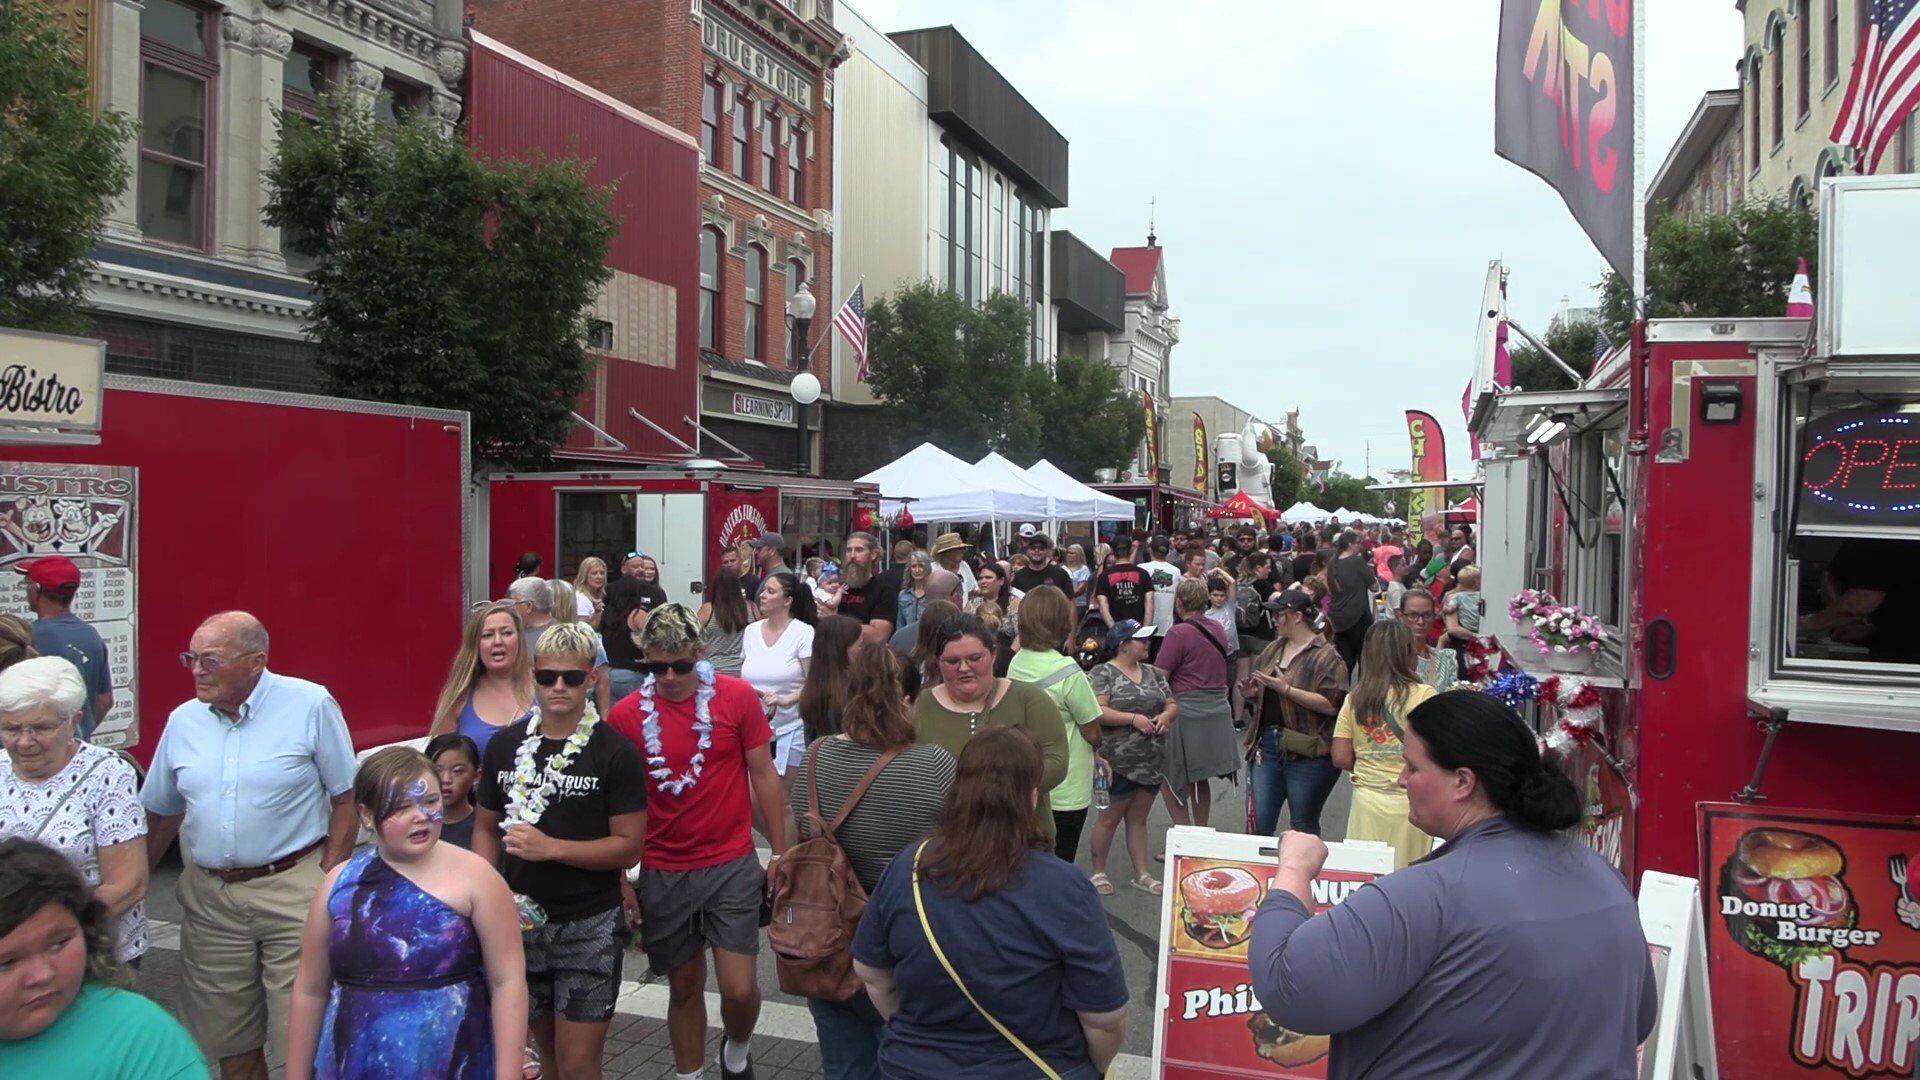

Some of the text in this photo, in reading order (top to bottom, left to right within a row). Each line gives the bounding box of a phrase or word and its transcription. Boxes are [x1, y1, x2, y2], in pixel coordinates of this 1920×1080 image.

[704, 16, 807, 106] DRUG STORE
[1, 364, 84, 415] Bistro
[0, 475, 133, 497] ISTRO
[1721, 895, 1811, 919] Donut
[1777, 920, 1881, 948] Burger
